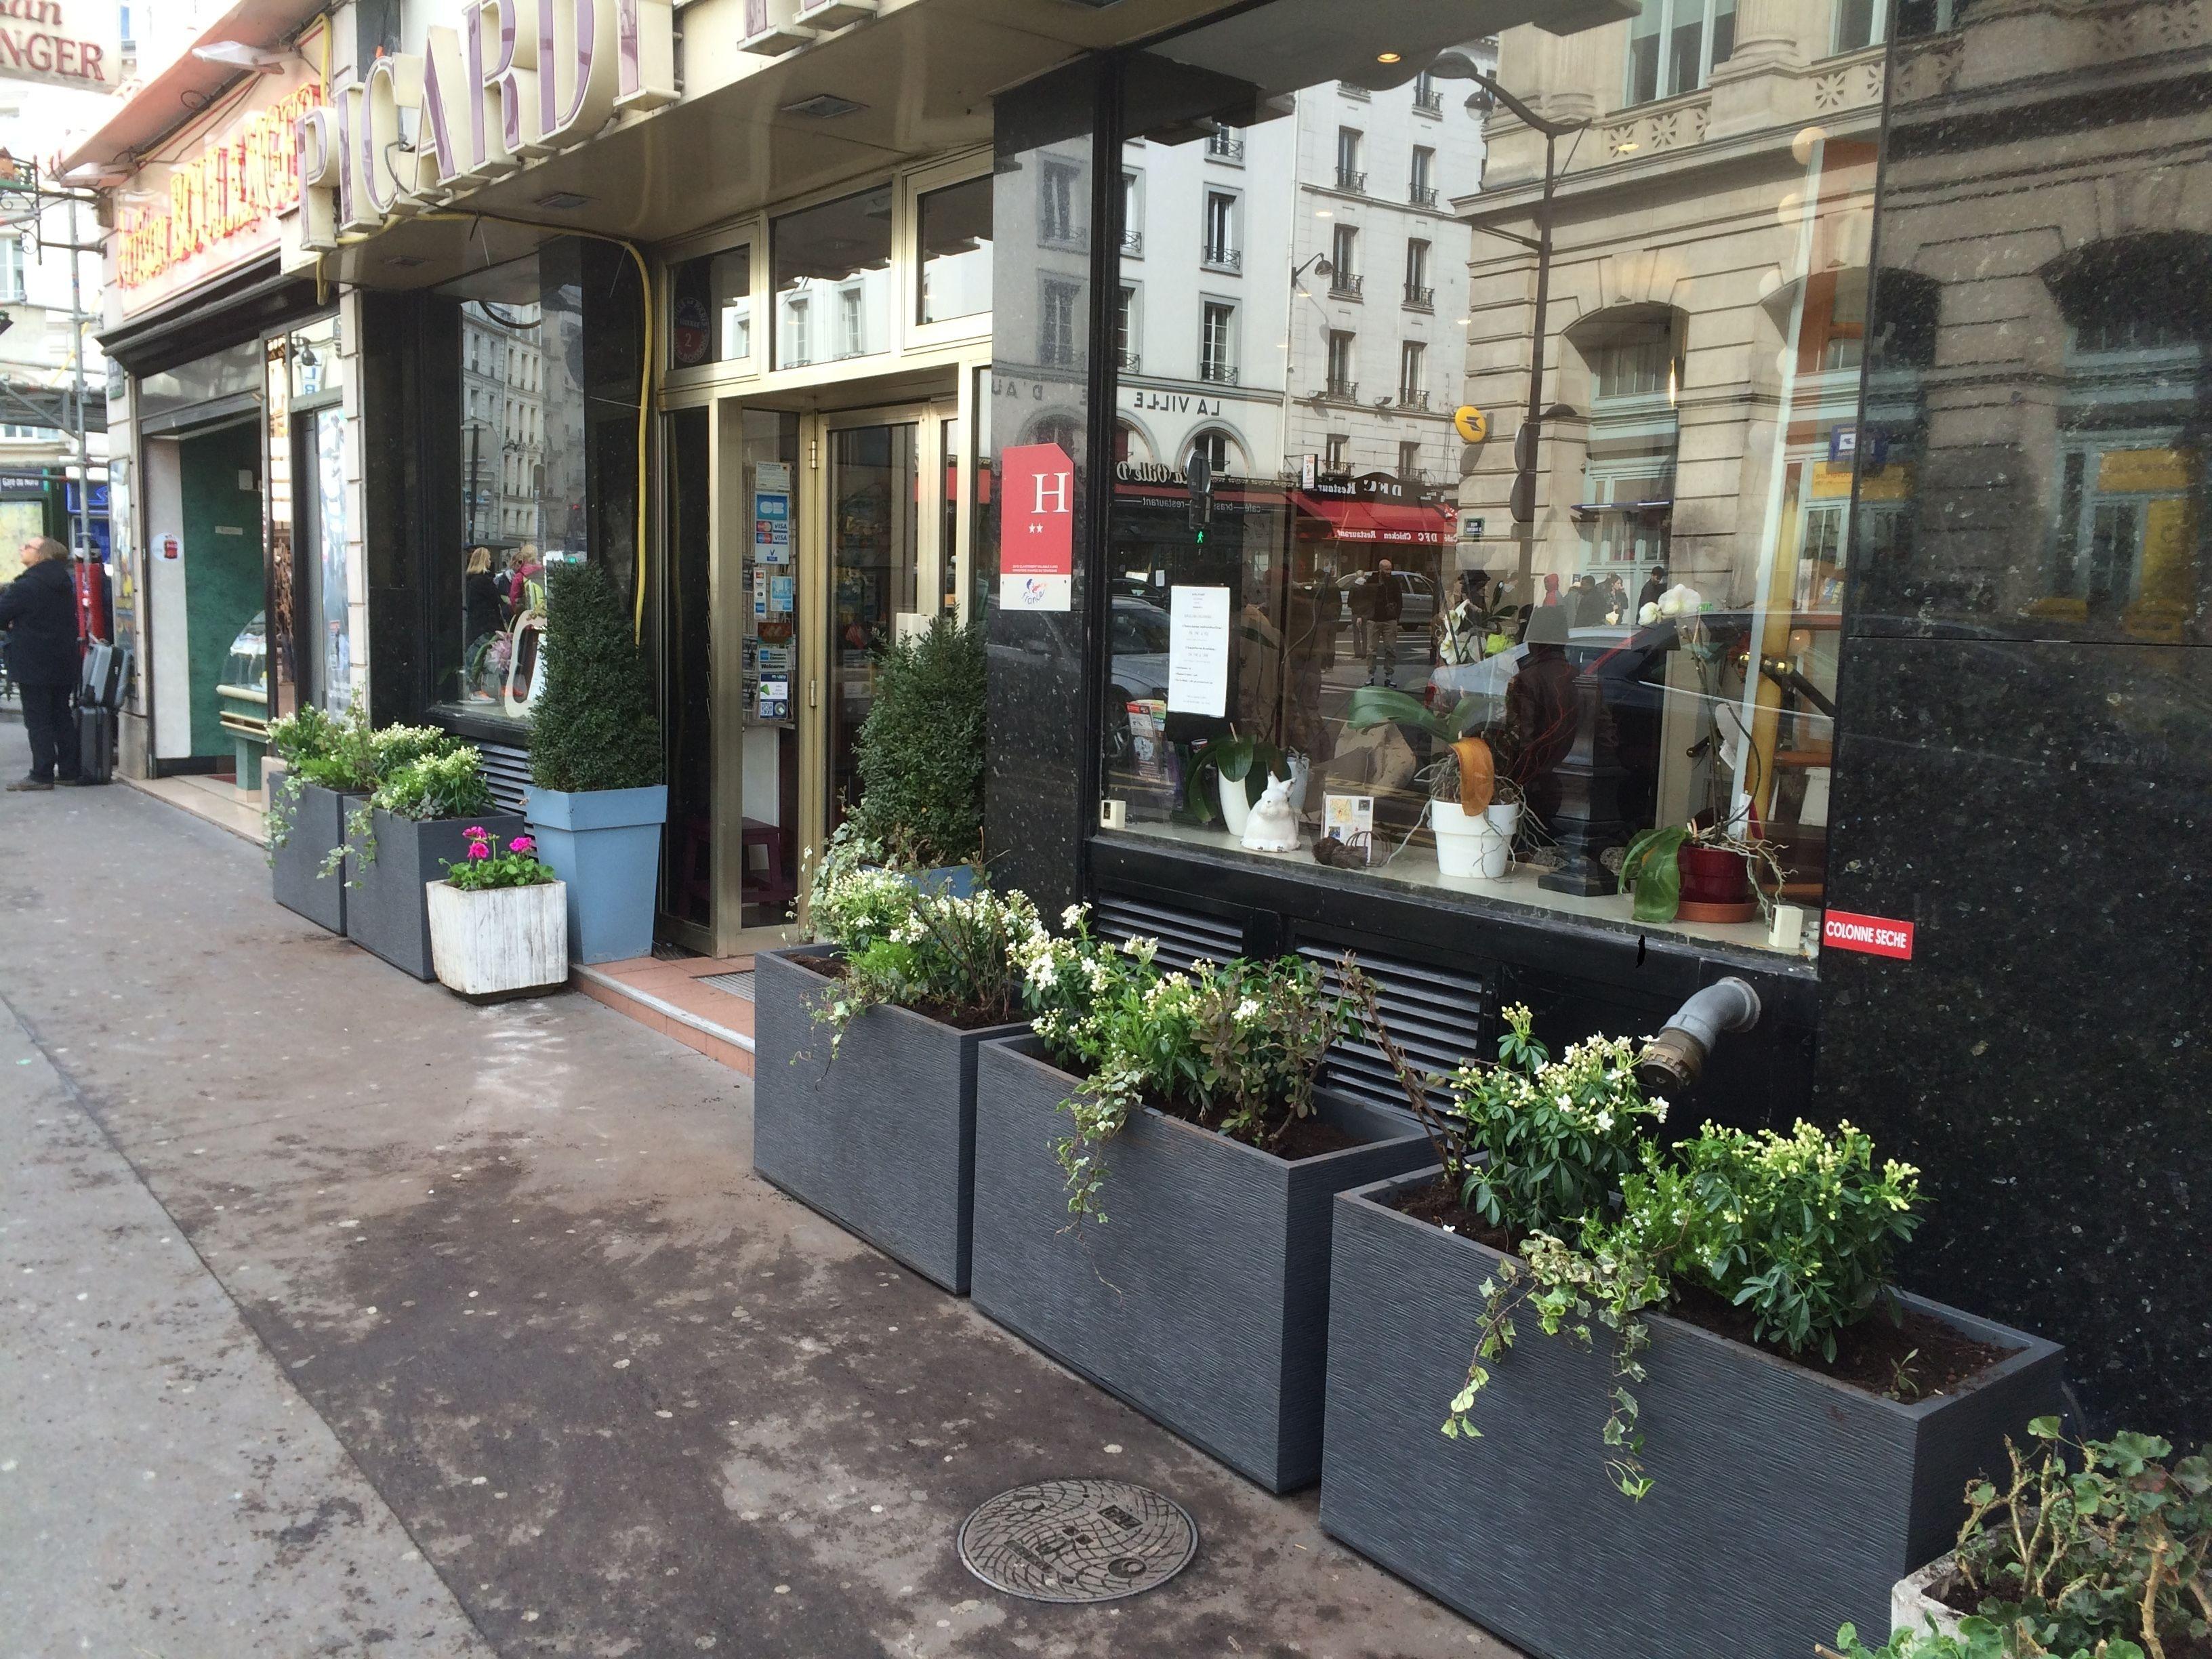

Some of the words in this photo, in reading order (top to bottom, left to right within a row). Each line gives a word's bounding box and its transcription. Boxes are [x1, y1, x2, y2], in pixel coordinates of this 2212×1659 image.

[684, 333, 692, 348] 2
[1031, 472, 1070, 513] H
[1826, 920, 1875, 943] COLONNE
[1875, 928, 1907, 949] SECHE
